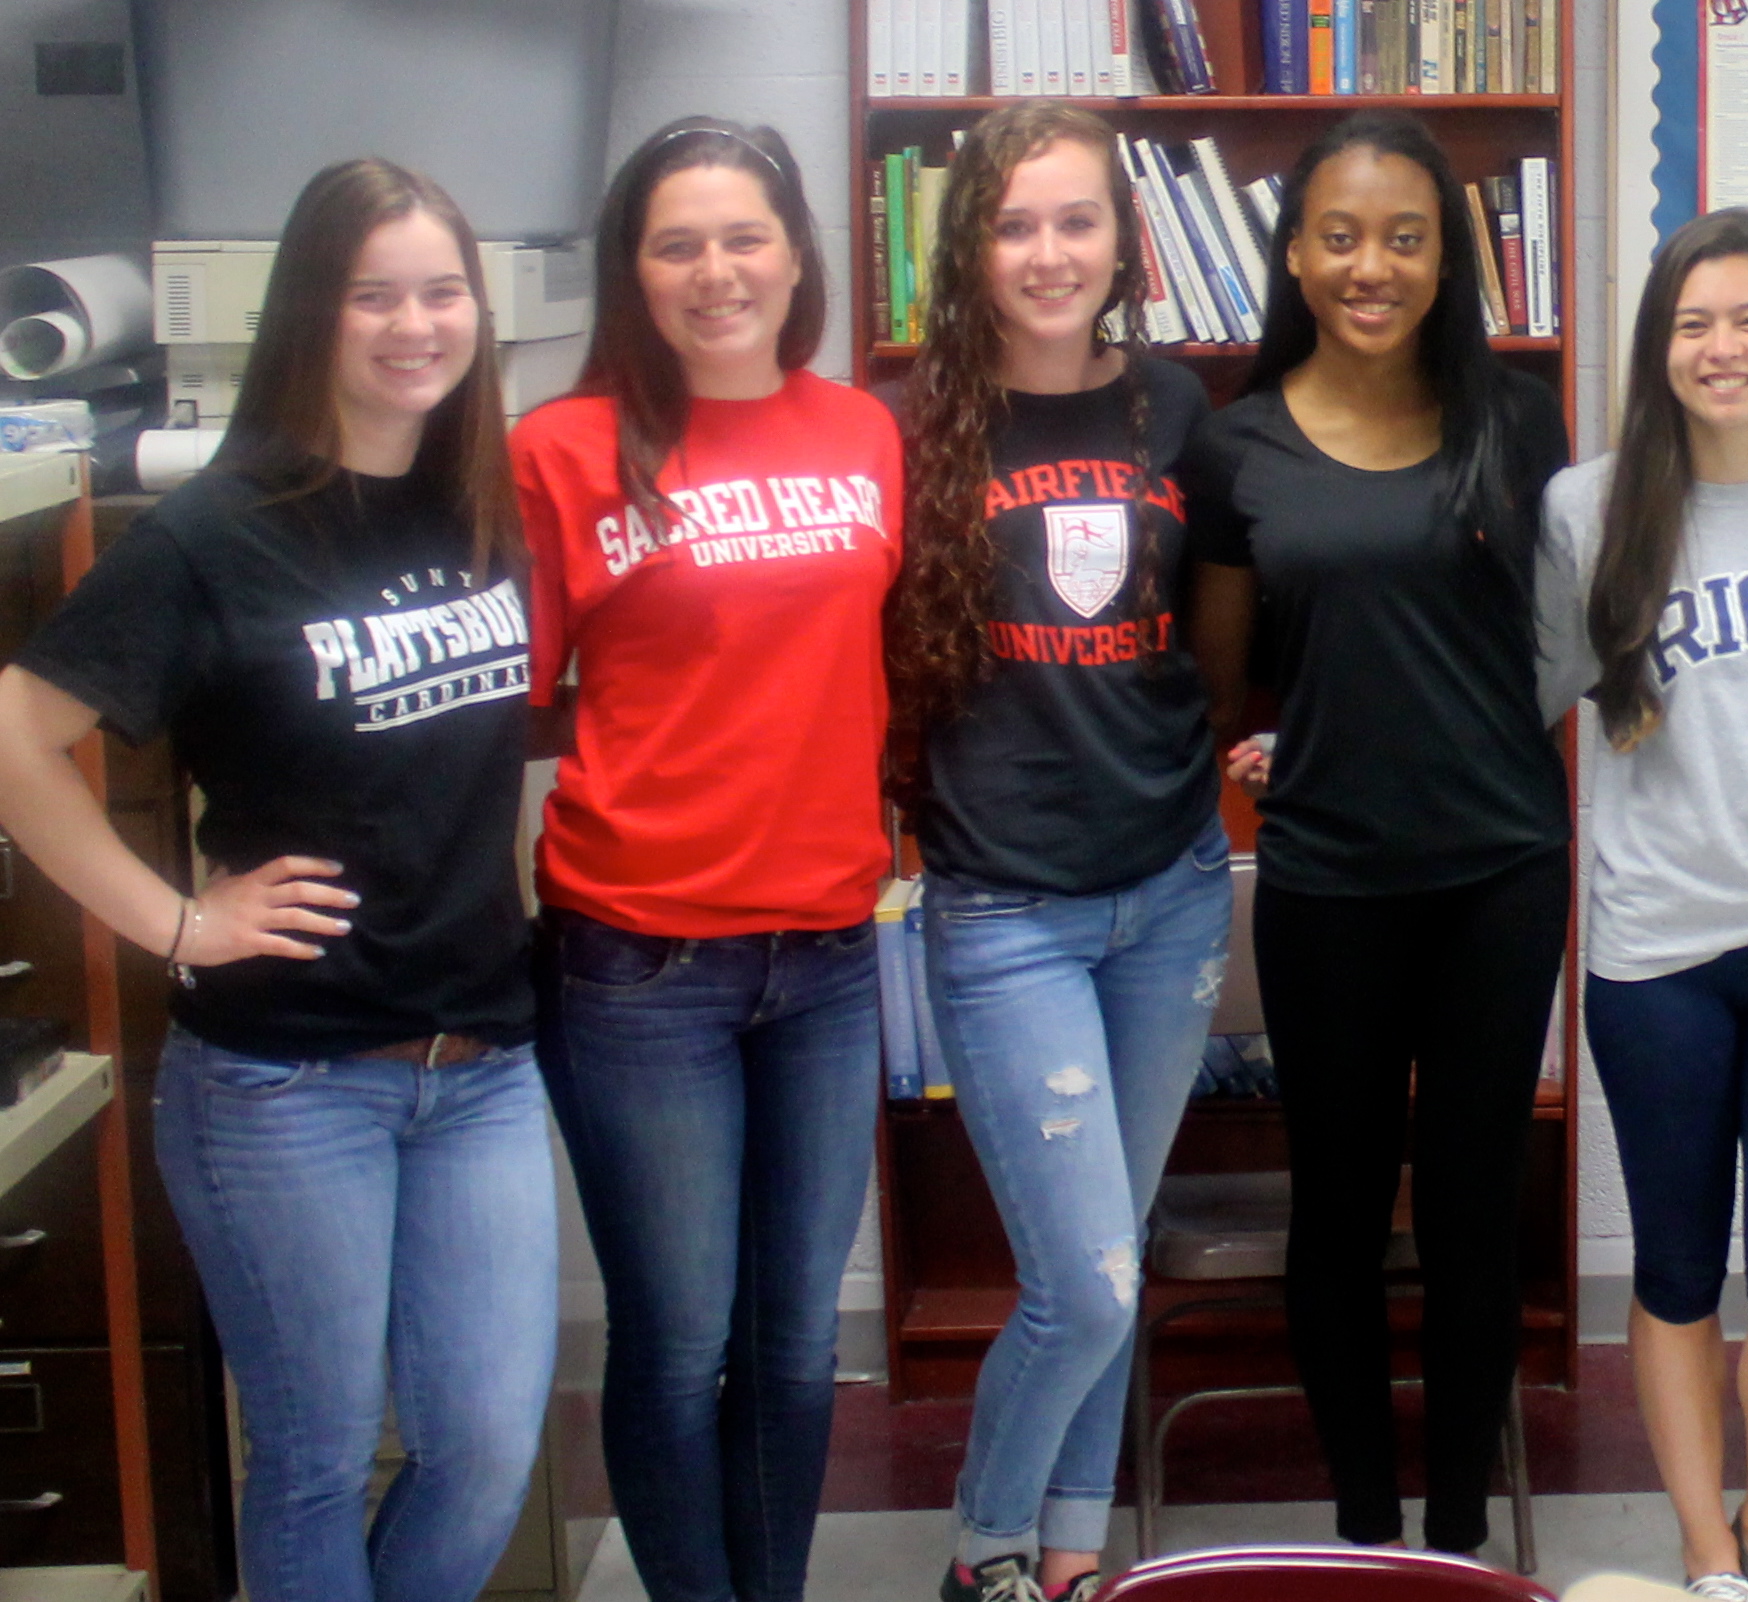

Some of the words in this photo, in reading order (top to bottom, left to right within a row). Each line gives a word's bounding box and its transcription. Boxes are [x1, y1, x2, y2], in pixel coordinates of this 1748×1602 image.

[982, 459, 1187, 525] AIRFIE
[690, 527, 857, 567] UNIVERSITY
[381, 568, 472, 606] SUNY
[370, 664, 530, 722] CARDINA
